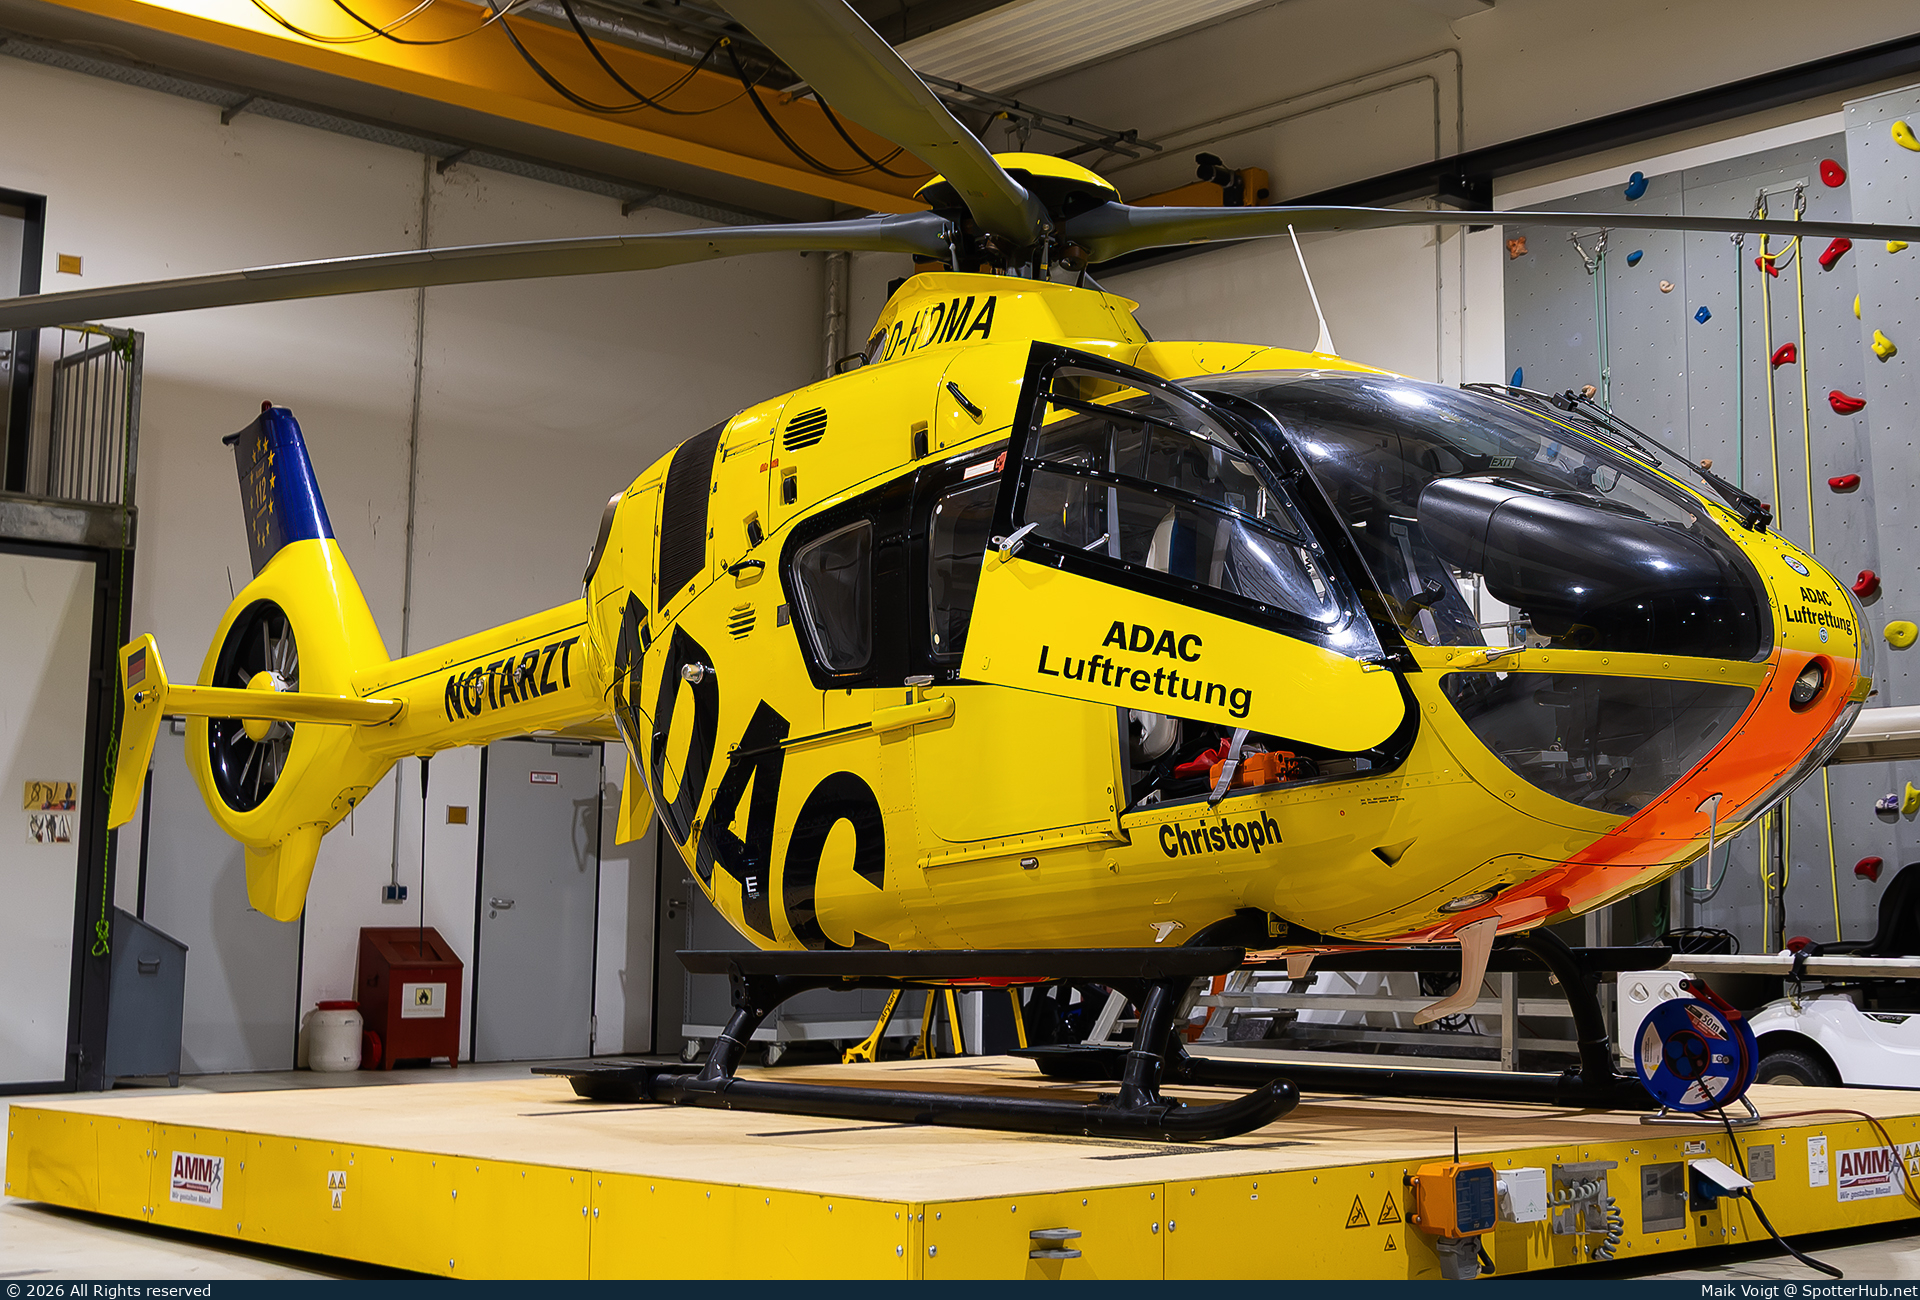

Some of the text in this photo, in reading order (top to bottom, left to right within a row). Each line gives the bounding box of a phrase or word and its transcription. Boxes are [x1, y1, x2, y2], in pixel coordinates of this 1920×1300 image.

[884, 296, 997, 361] D-HDMA
[1491, 457, 1514, 467] EXIT
[255, 476, 266, 509] 112
[1800, 586, 1832, 606] ADAC
[1784, 604, 1853, 636] Luftrettung
[1102, 620, 1203, 662] ADAC
[444, 635, 581, 723] NOTARZT
[1038, 645, 1253, 718] Luftrettung
[1158, 810, 1283, 859] Christoph
[174, 1155, 212, 1182] AMM
[1840, 1149, 1890, 1178] AMM
